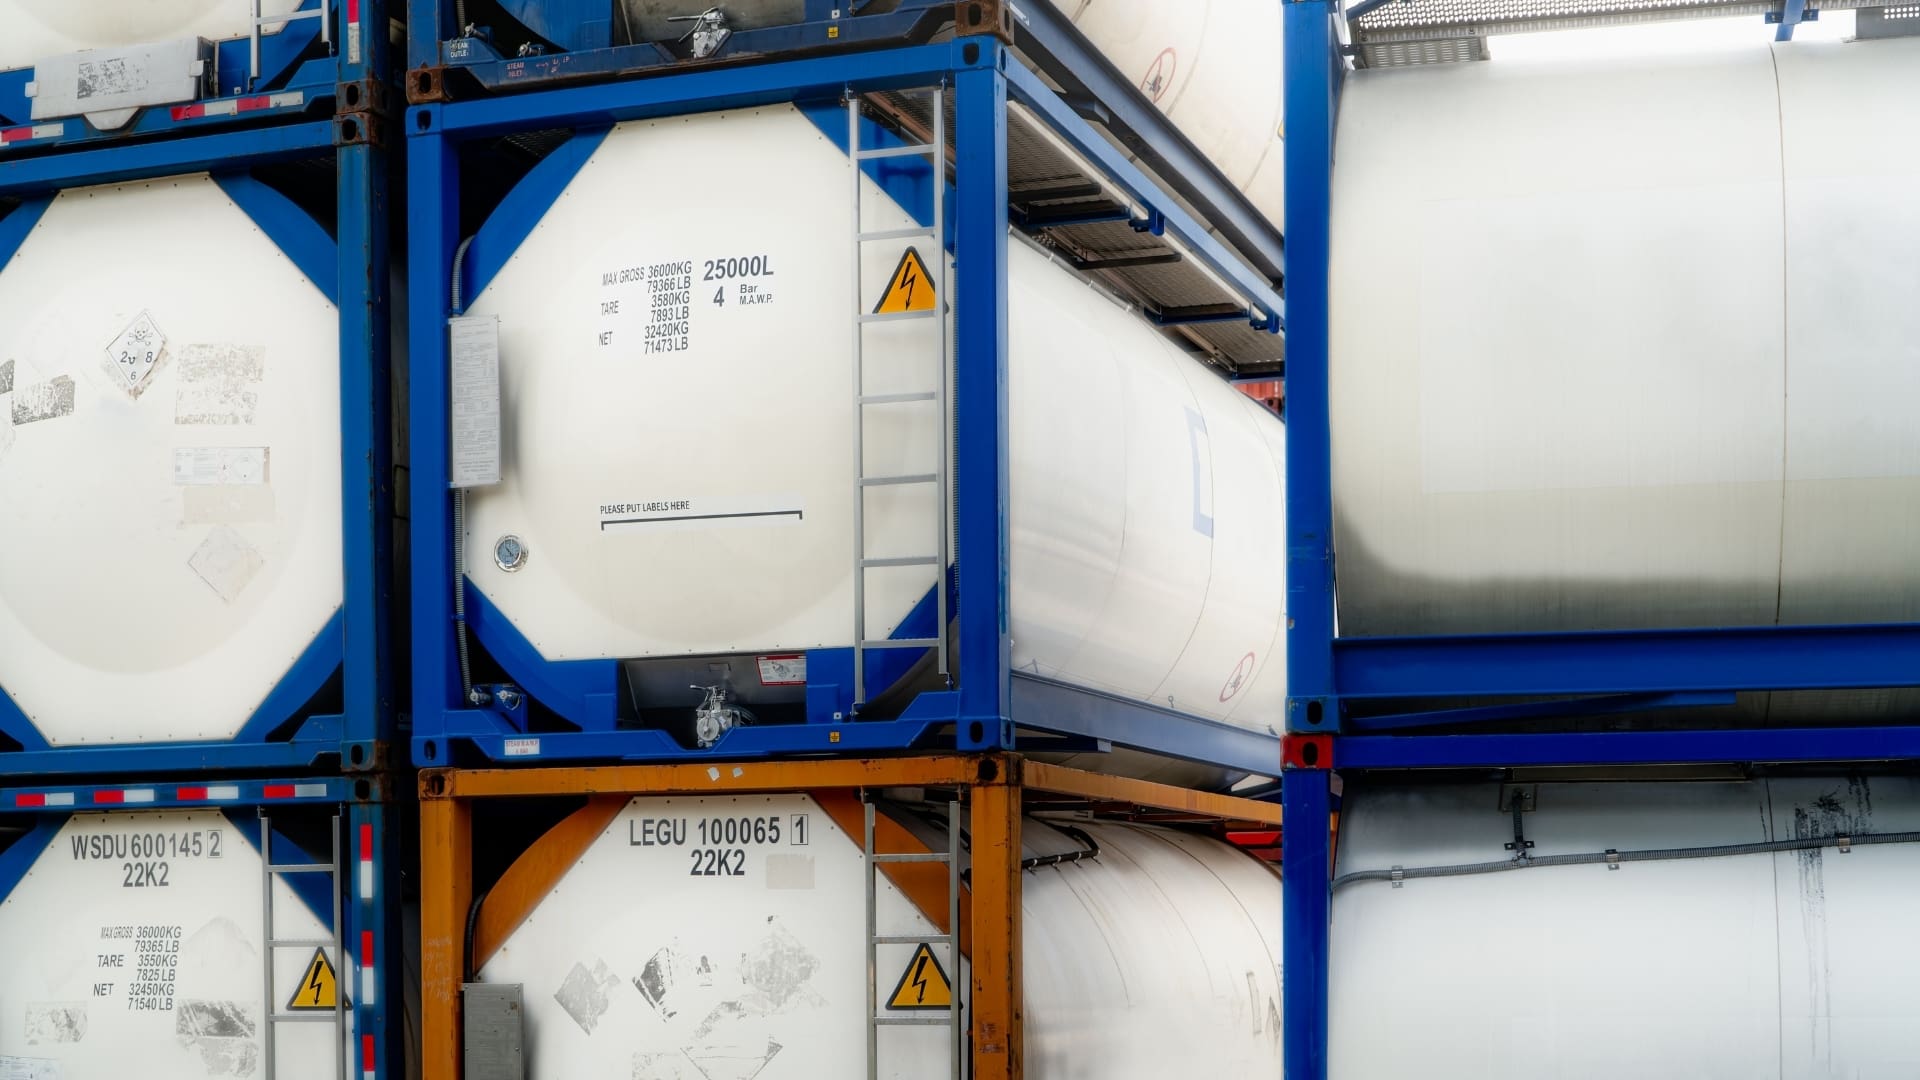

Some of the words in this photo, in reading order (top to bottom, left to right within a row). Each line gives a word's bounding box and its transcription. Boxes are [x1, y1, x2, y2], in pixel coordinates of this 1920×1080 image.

[602, 271, 618, 286] MAX
[619, 266, 645, 284] GROSS
[648, 261, 692, 279] 36000KG
[704, 255, 774, 281] 25000L
[647, 277, 676, 294] 79366
[677, 276, 691, 290] LB
[601, 300, 619, 316] TARE
[651, 291, 690, 308] 3580KG
[713, 286, 725, 307] 4
[740, 284, 758, 294] Bar
[739, 294, 773, 305] M.A.W.P.
[651, 309, 674, 323] 7893
[676, 306, 689, 320] LB
[599, 331, 612, 346] NET
[645, 321, 689, 339] 32420KG
[644, 340, 673, 354] 71473
[675, 337, 688, 351] LB
[130, 371, 136, 380] 6
[600, 504, 625, 514] PLEASE
[626, 503, 640, 513] PUT
[642, 502, 669, 512] LABELS
[670, 500, 690, 510] HERE
[630, 818, 686, 846] LEGU
[698, 816, 780, 845] 100065
[795, 815, 804, 844] 1
[72, 834, 127, 860] WSDU
[131, 832, 202, 858] 600145
[209, 832, 221, 857] 2
[690, 849, 745, 876] 22K2
[122, 861, 169, 887] 22K2
[100, 927, 113, 939] MAX
[113, 926, 133, 938] GROSS
[136, 926, 182, 938] 36000KG
[134, 940, 163, 952] 79365
[165, 940, 180, 952] LB
[98, 954, 124, 968] TARE
[138, 954, 178, 967] 3550KG
[136, 969, 160, 982] 7825
[161, 969, 176, 981] LB
[93, 983, 113, 996] NET
[129, 983, 174, 996] 32450KG
[128, 998, 157, 1010] 71540
[159, 998, 173, 1010] LB
